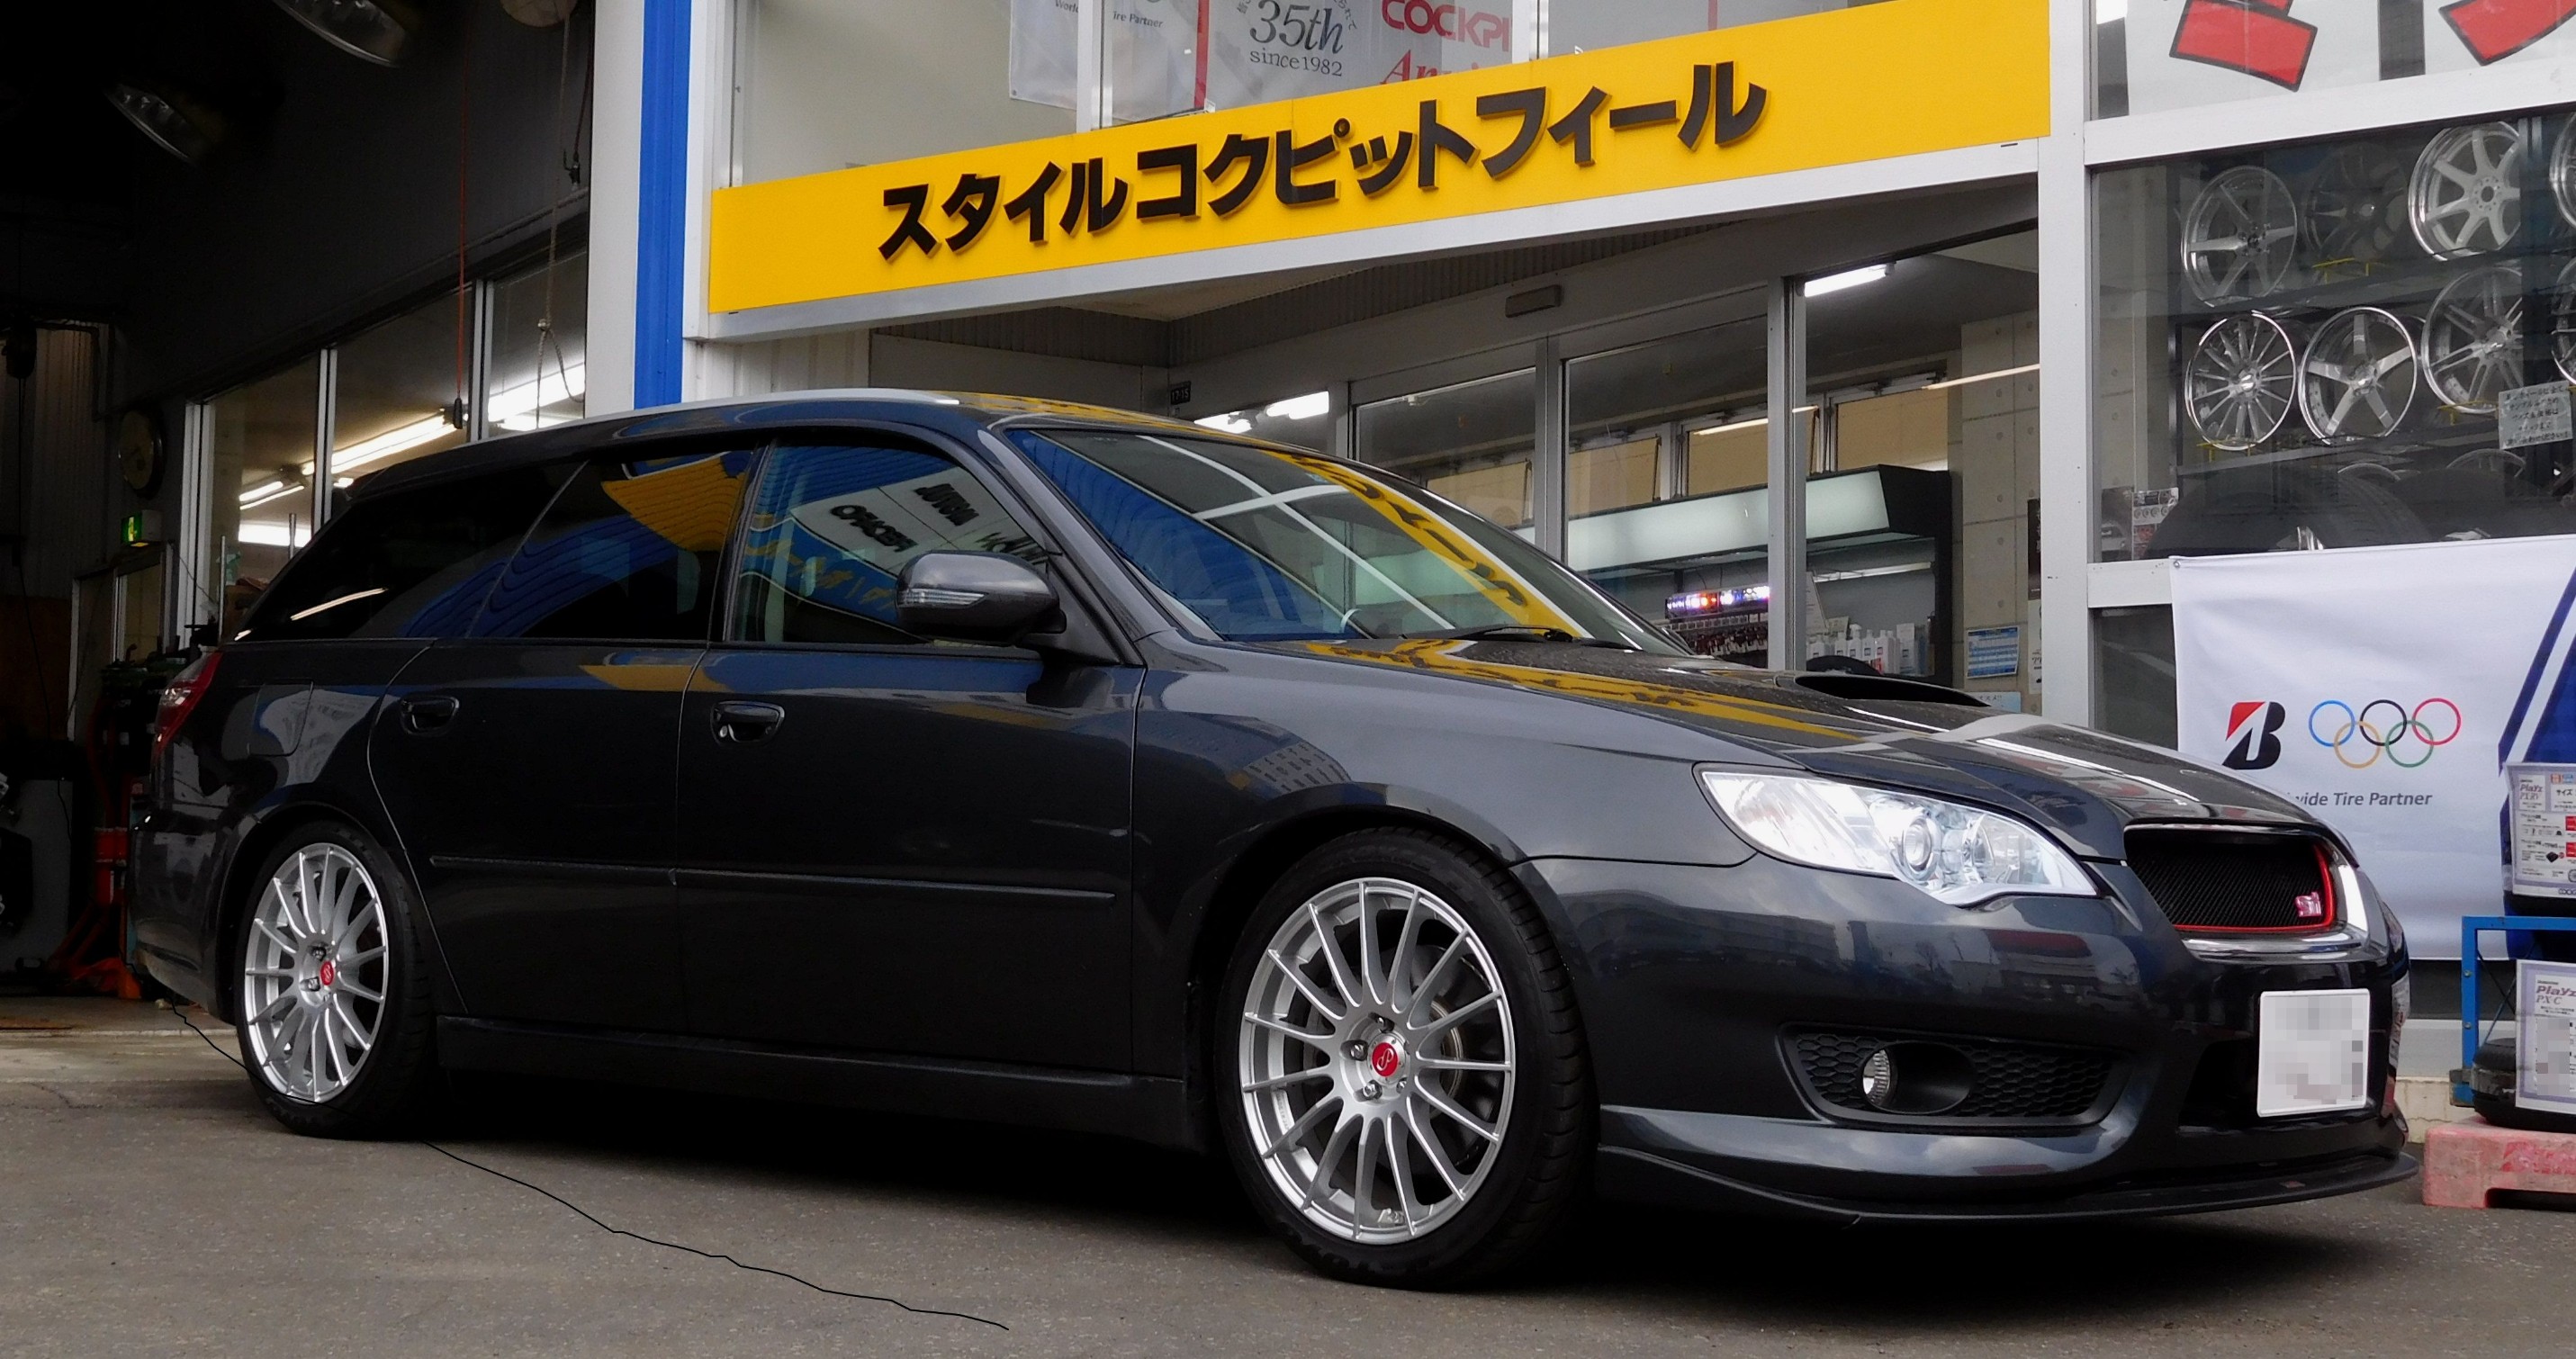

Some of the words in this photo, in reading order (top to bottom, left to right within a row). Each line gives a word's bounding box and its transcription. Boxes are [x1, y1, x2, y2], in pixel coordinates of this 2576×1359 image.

[1129, 14, 1164, 29] Partner
[1249, 0, 1344, 54] 35th
[1382, 0, 1512, 52] COCKPI
[2333, 792, 2364, 806] Tire
[2369, 793, 2433, 806] Partner
